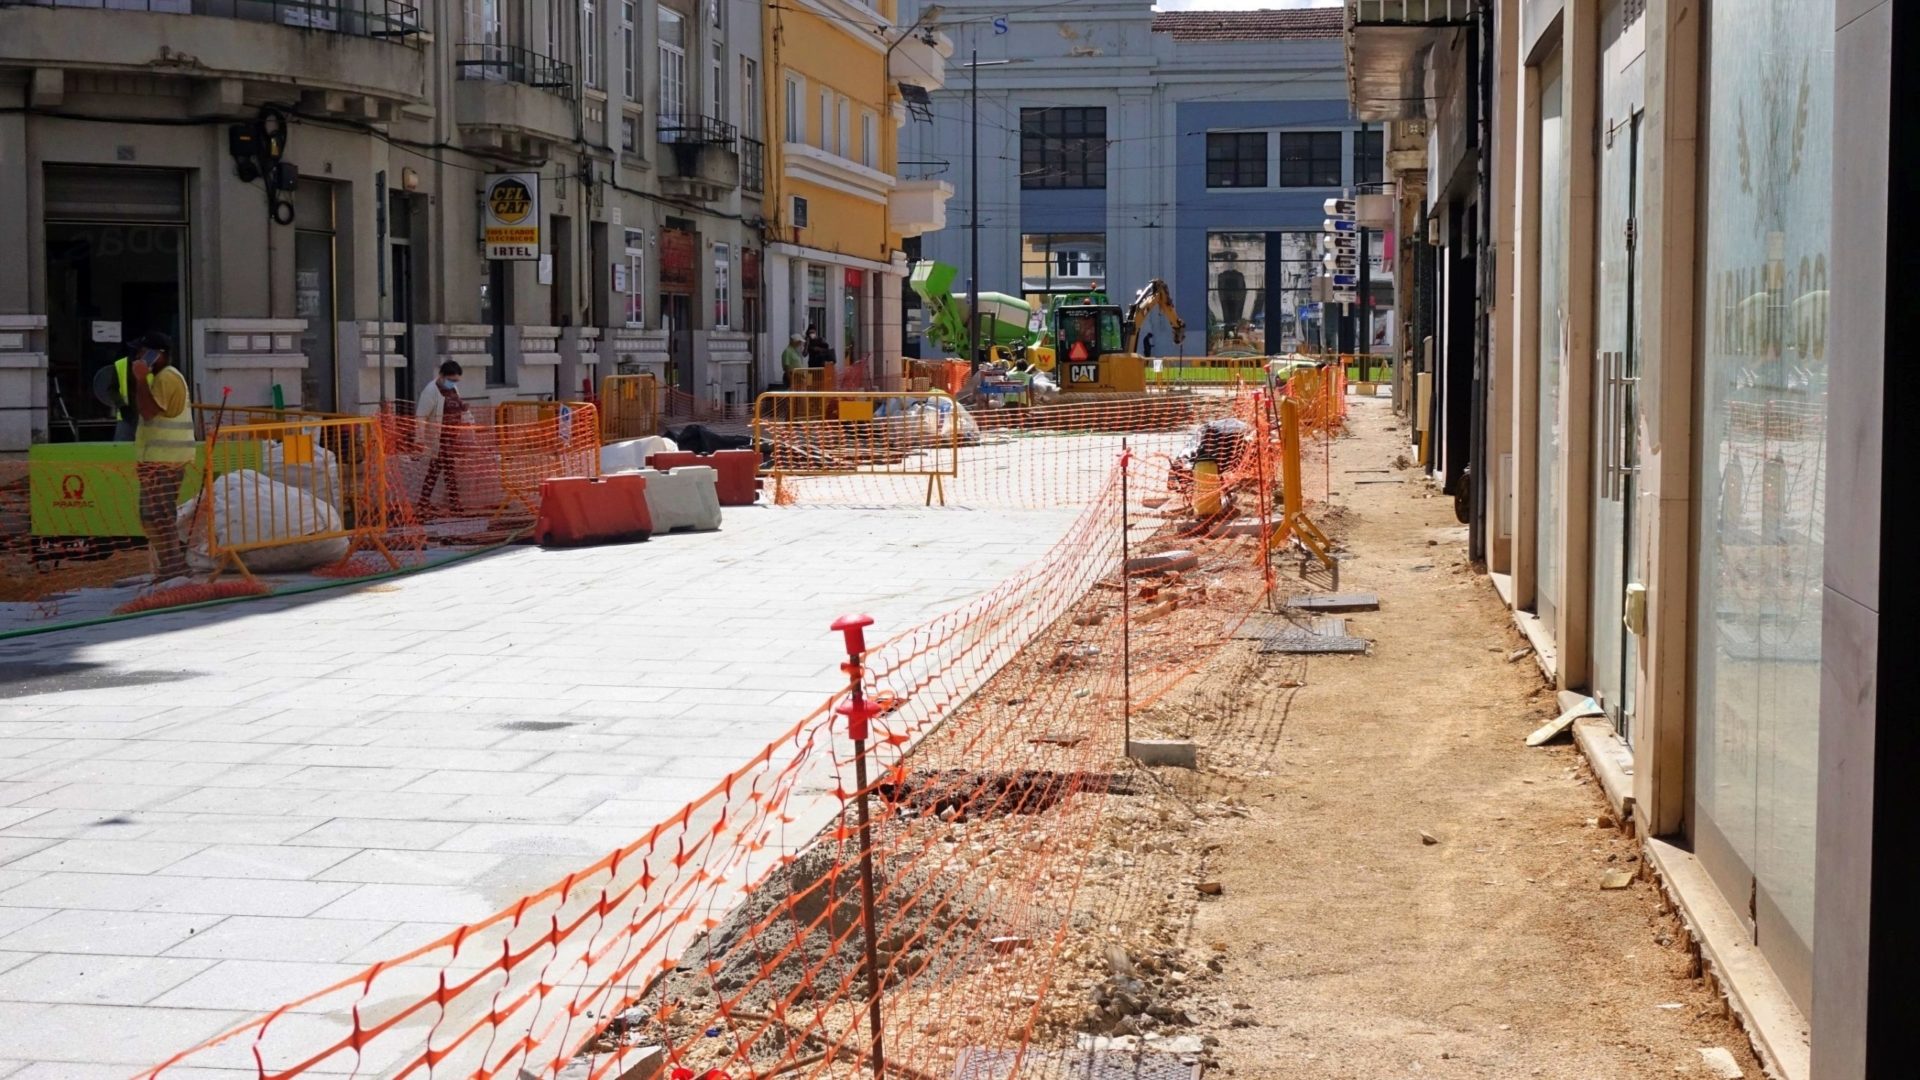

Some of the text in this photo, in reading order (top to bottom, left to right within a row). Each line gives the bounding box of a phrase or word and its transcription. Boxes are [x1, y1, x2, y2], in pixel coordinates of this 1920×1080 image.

[994, 18, 1008, 35] S
[495, 201, 529, 214] CAT
[493, 246, 532, 257] IRTEL
[1071, 365, 1097, 382] CAT
